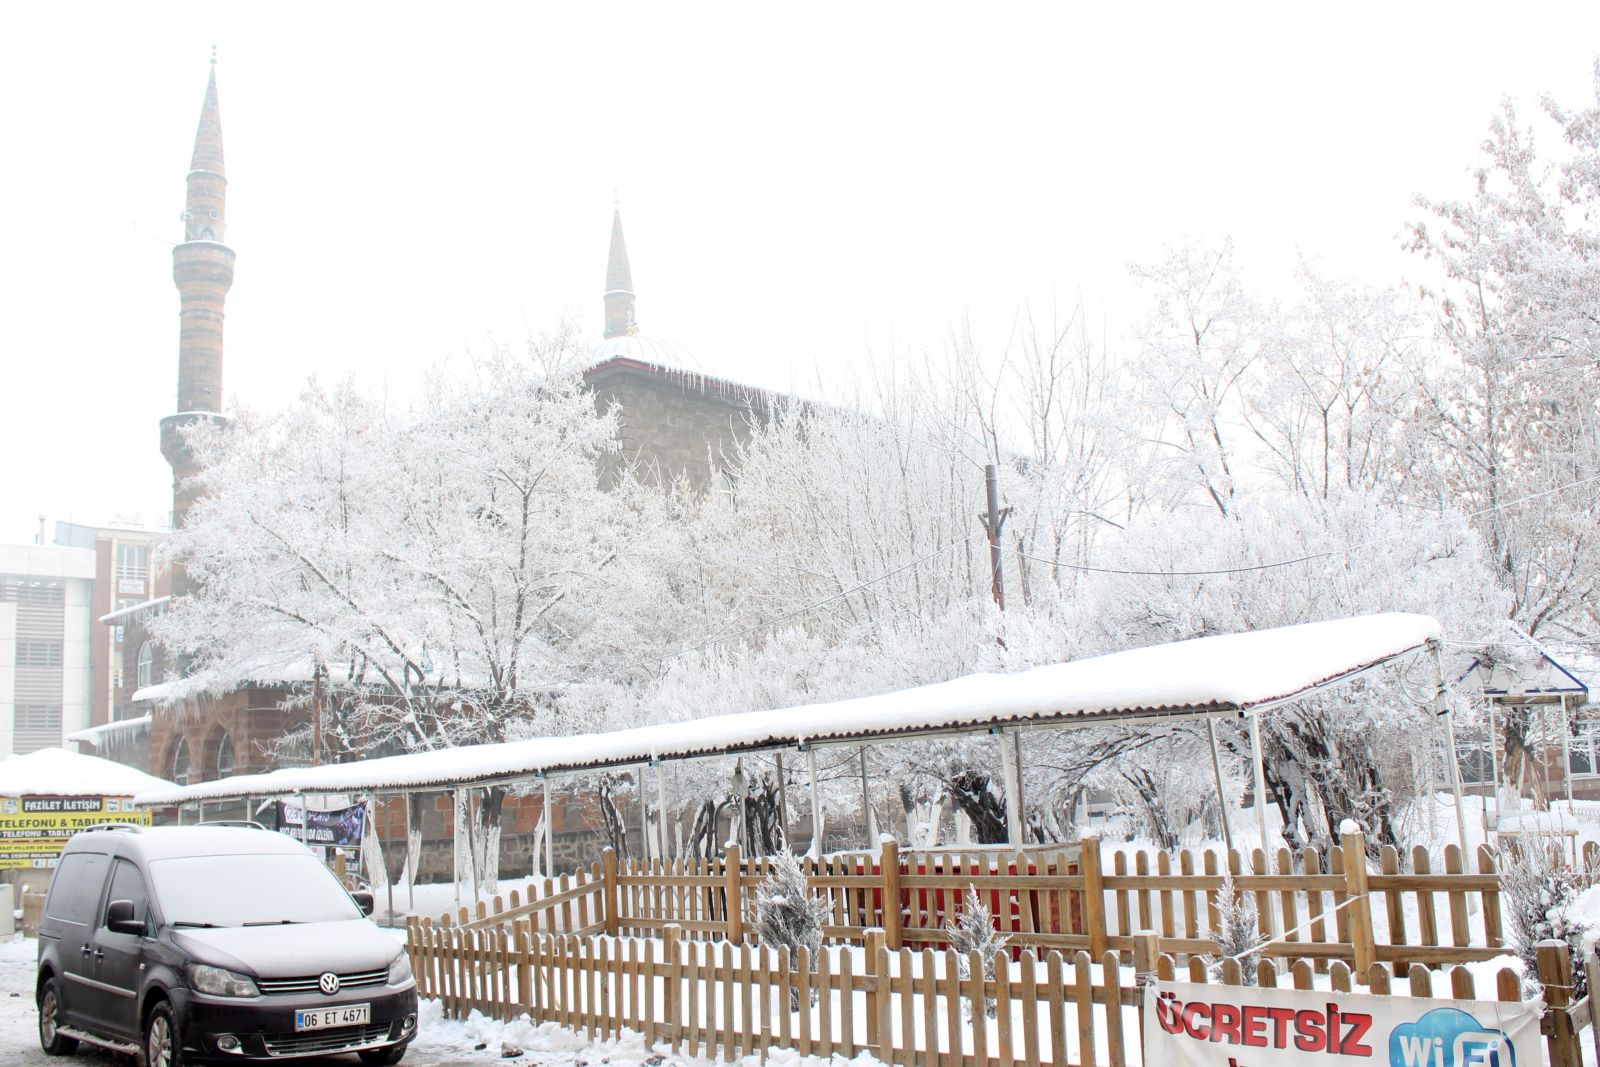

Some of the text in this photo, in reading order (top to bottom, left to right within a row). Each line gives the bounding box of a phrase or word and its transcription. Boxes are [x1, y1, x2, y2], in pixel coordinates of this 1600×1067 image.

[24, 799, 100, 811] FAZİLET İLETİŞİM
[0, 818, 56, 828] TELEFONU
[60, 819, 67, 827] &
[2, 830, 42, 838] TELEFONU
[304, 1014, 318, 1027] 06
[325, 1012, 337, 1024] ET
[343, 1009, 367, 1022] 4671
[1156, 991, 1372, 1057] ÜCRETSİZ
